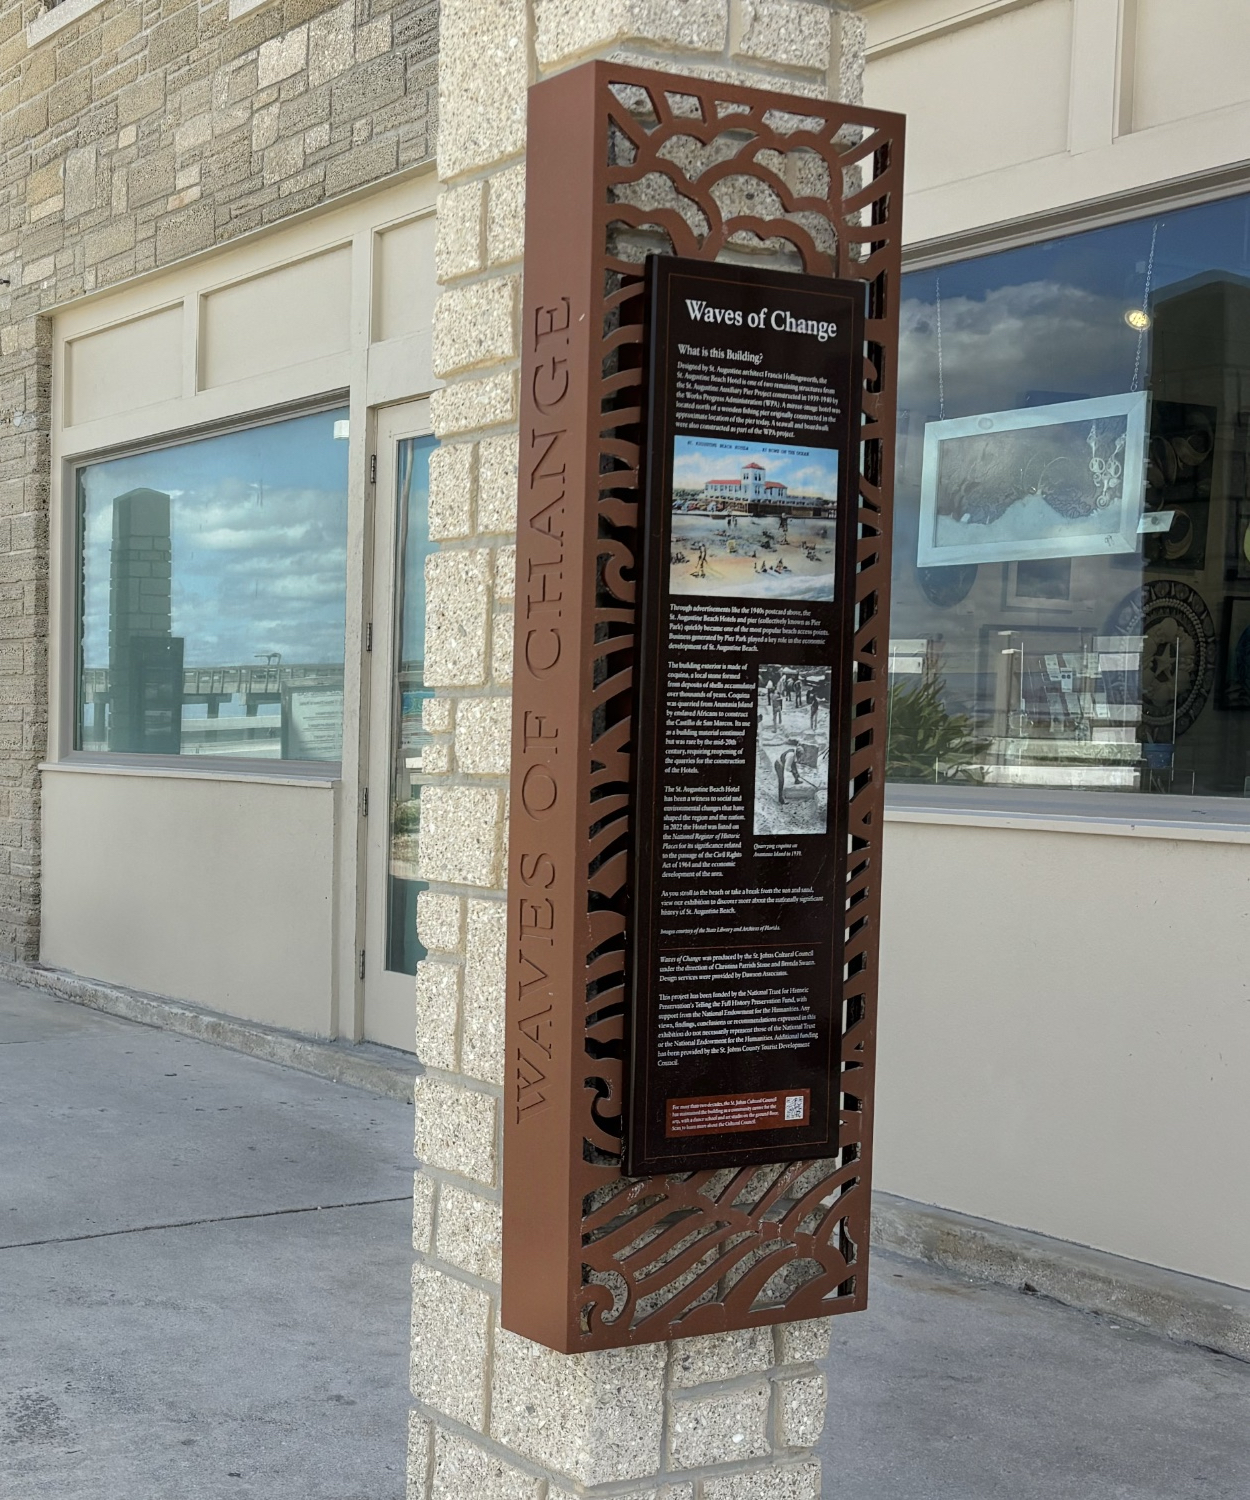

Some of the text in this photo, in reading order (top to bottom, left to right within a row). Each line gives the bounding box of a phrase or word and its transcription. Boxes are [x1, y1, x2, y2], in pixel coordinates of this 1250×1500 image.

[684, 298, 837, 341] Waves of Change
[676, 361, 701, 371] Designed
[677, 343, 763, 365] What is this Building?
[516, 296, 571, 1125] WAVES OF CHANGE
